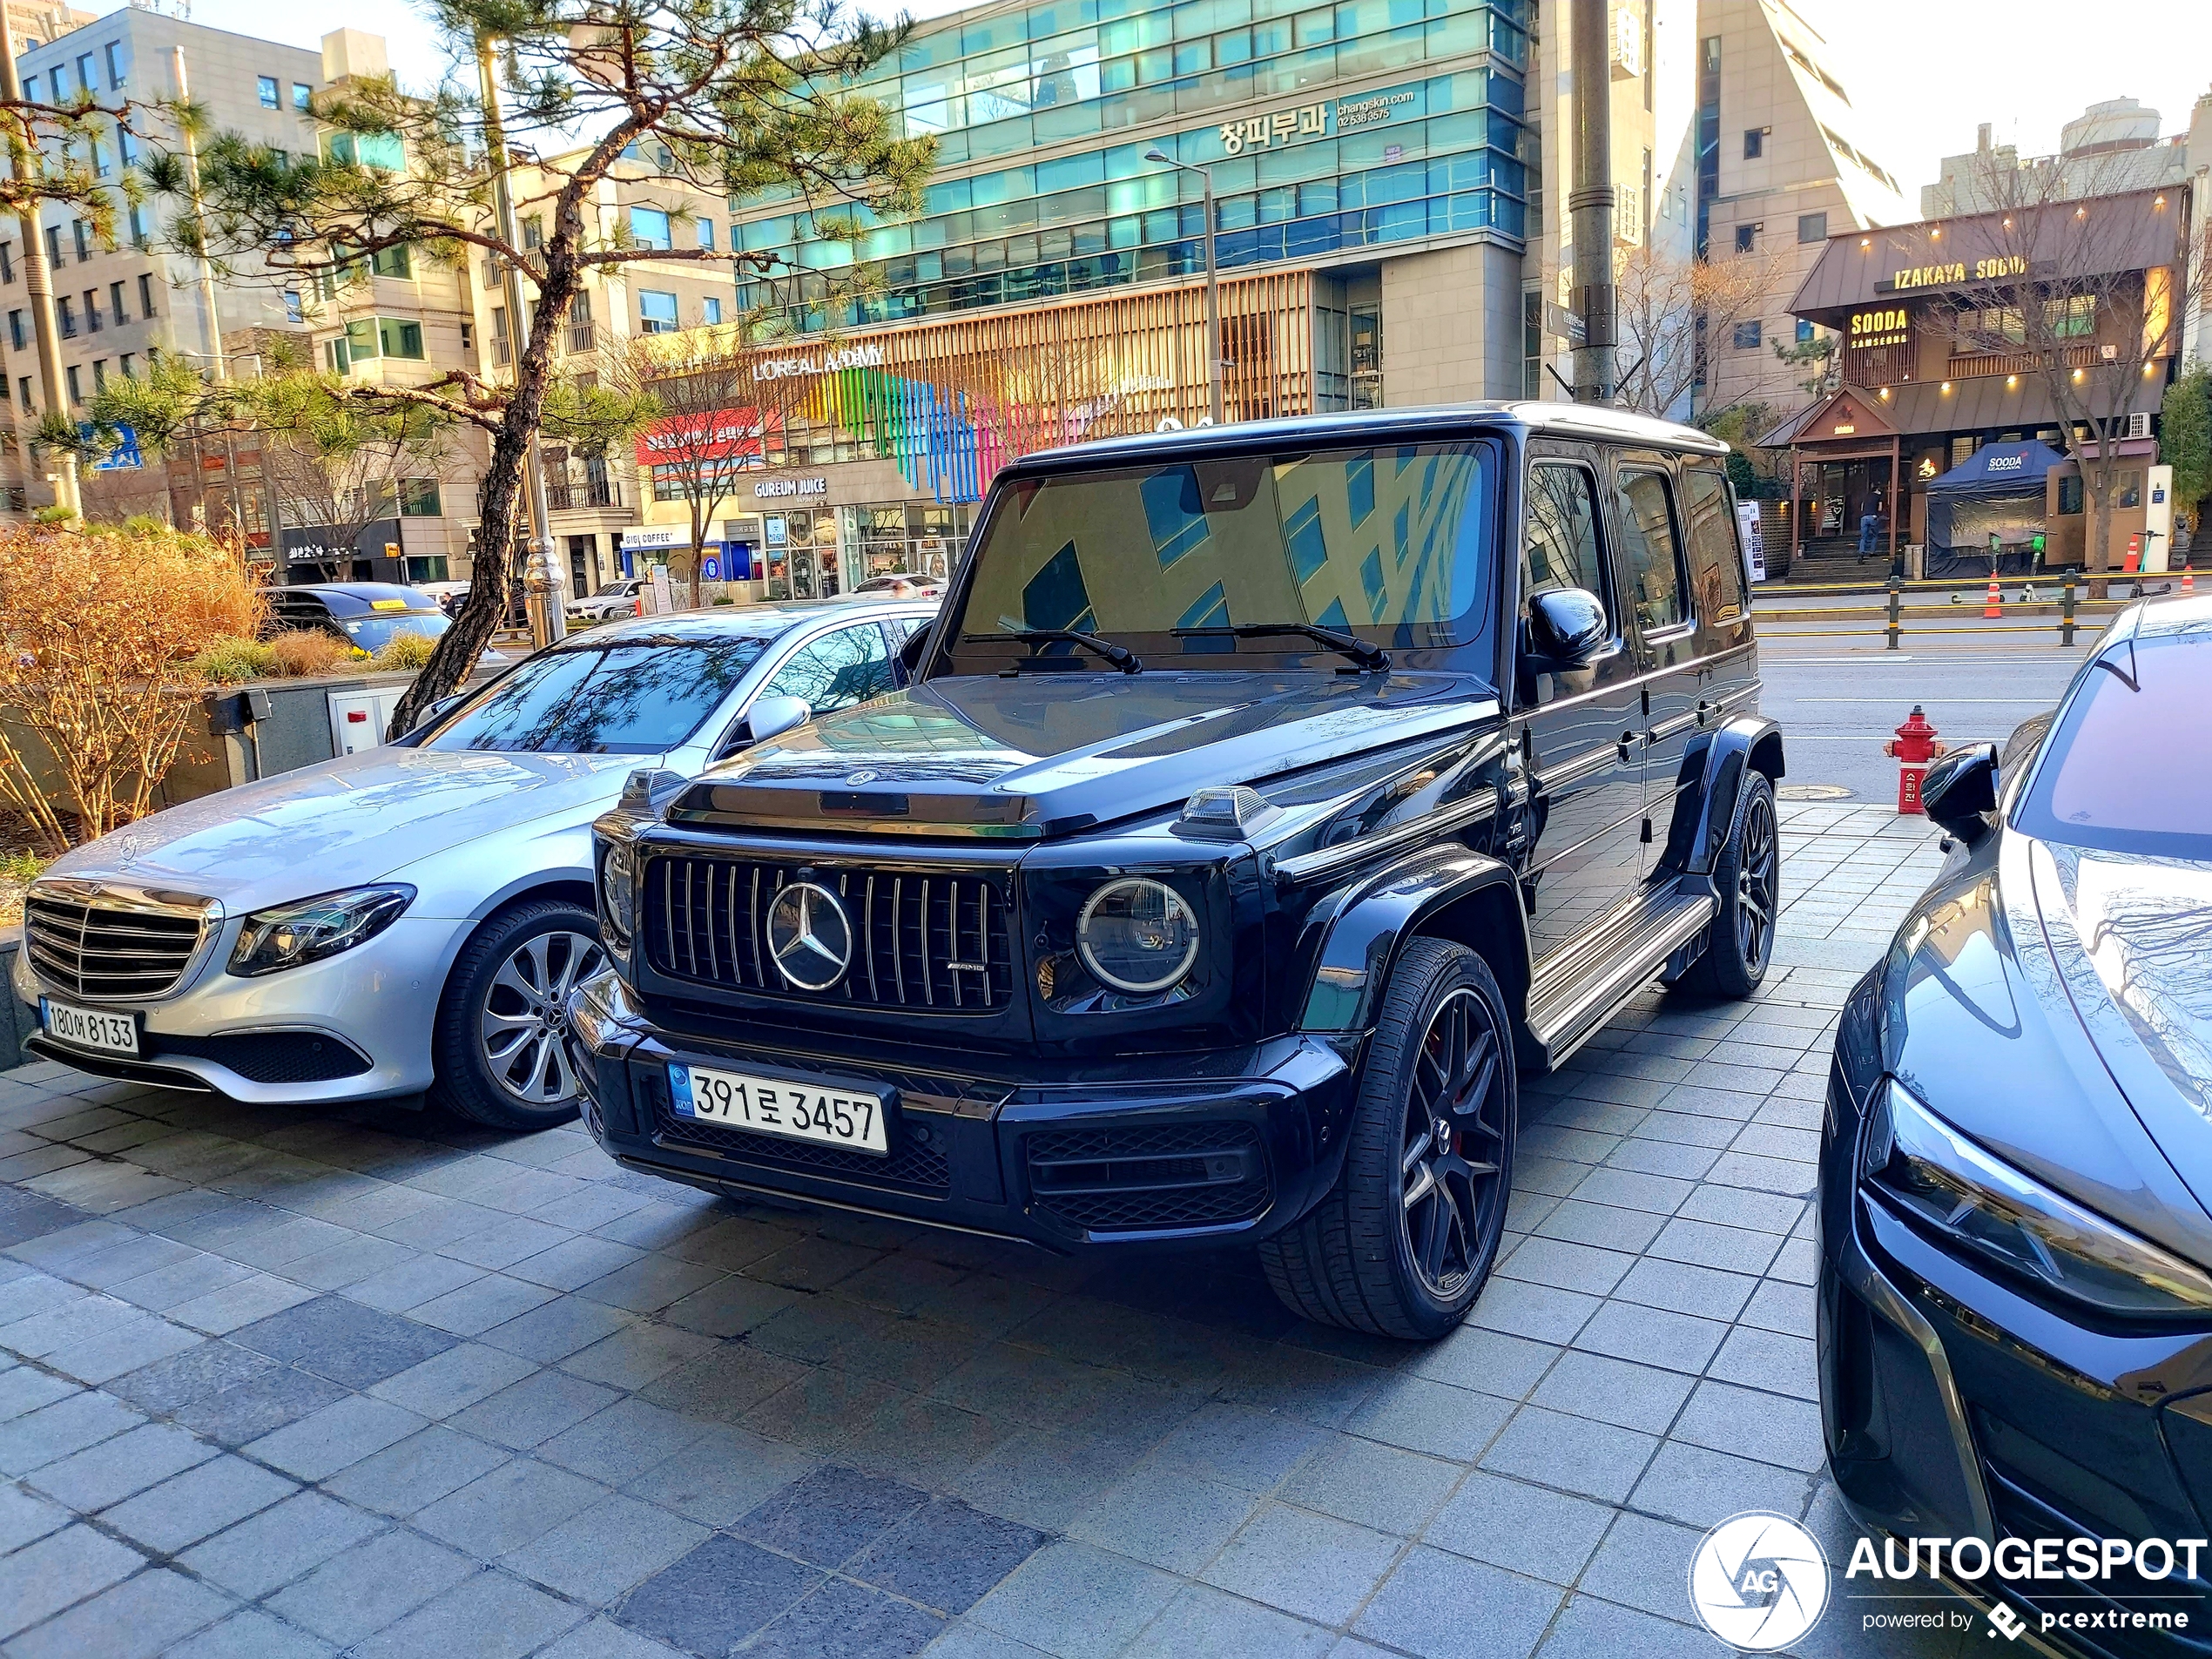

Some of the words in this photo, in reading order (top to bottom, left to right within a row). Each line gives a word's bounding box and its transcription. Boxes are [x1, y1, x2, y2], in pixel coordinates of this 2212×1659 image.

[1338, 91, 1414, 116] changskin.com
[1219, 103, 1329, 155] 창피부과
[1338, 116, 1349, 127] 02
[1894, 262, 1966, 290] IZAKAYA
[1851, 309, 1907, 334] SOODA
[1851, 334, 1907, 348] SAMSEONG
[1989, 455, 2021, 467] SOODA
[754, 480, 797, 498] GUREUM
[799, 478, 826, 495] JUICE
[626, 535, 640, 544] GIGI
[642, 533, 671, 543] COFFEE
[1905, 772, 1916, 803] 소화전
[88, 1015, 132, 1048] 8133
[694, 1075, 782, 1124] 391로
[788, 1091, 873, 1141] 3457
